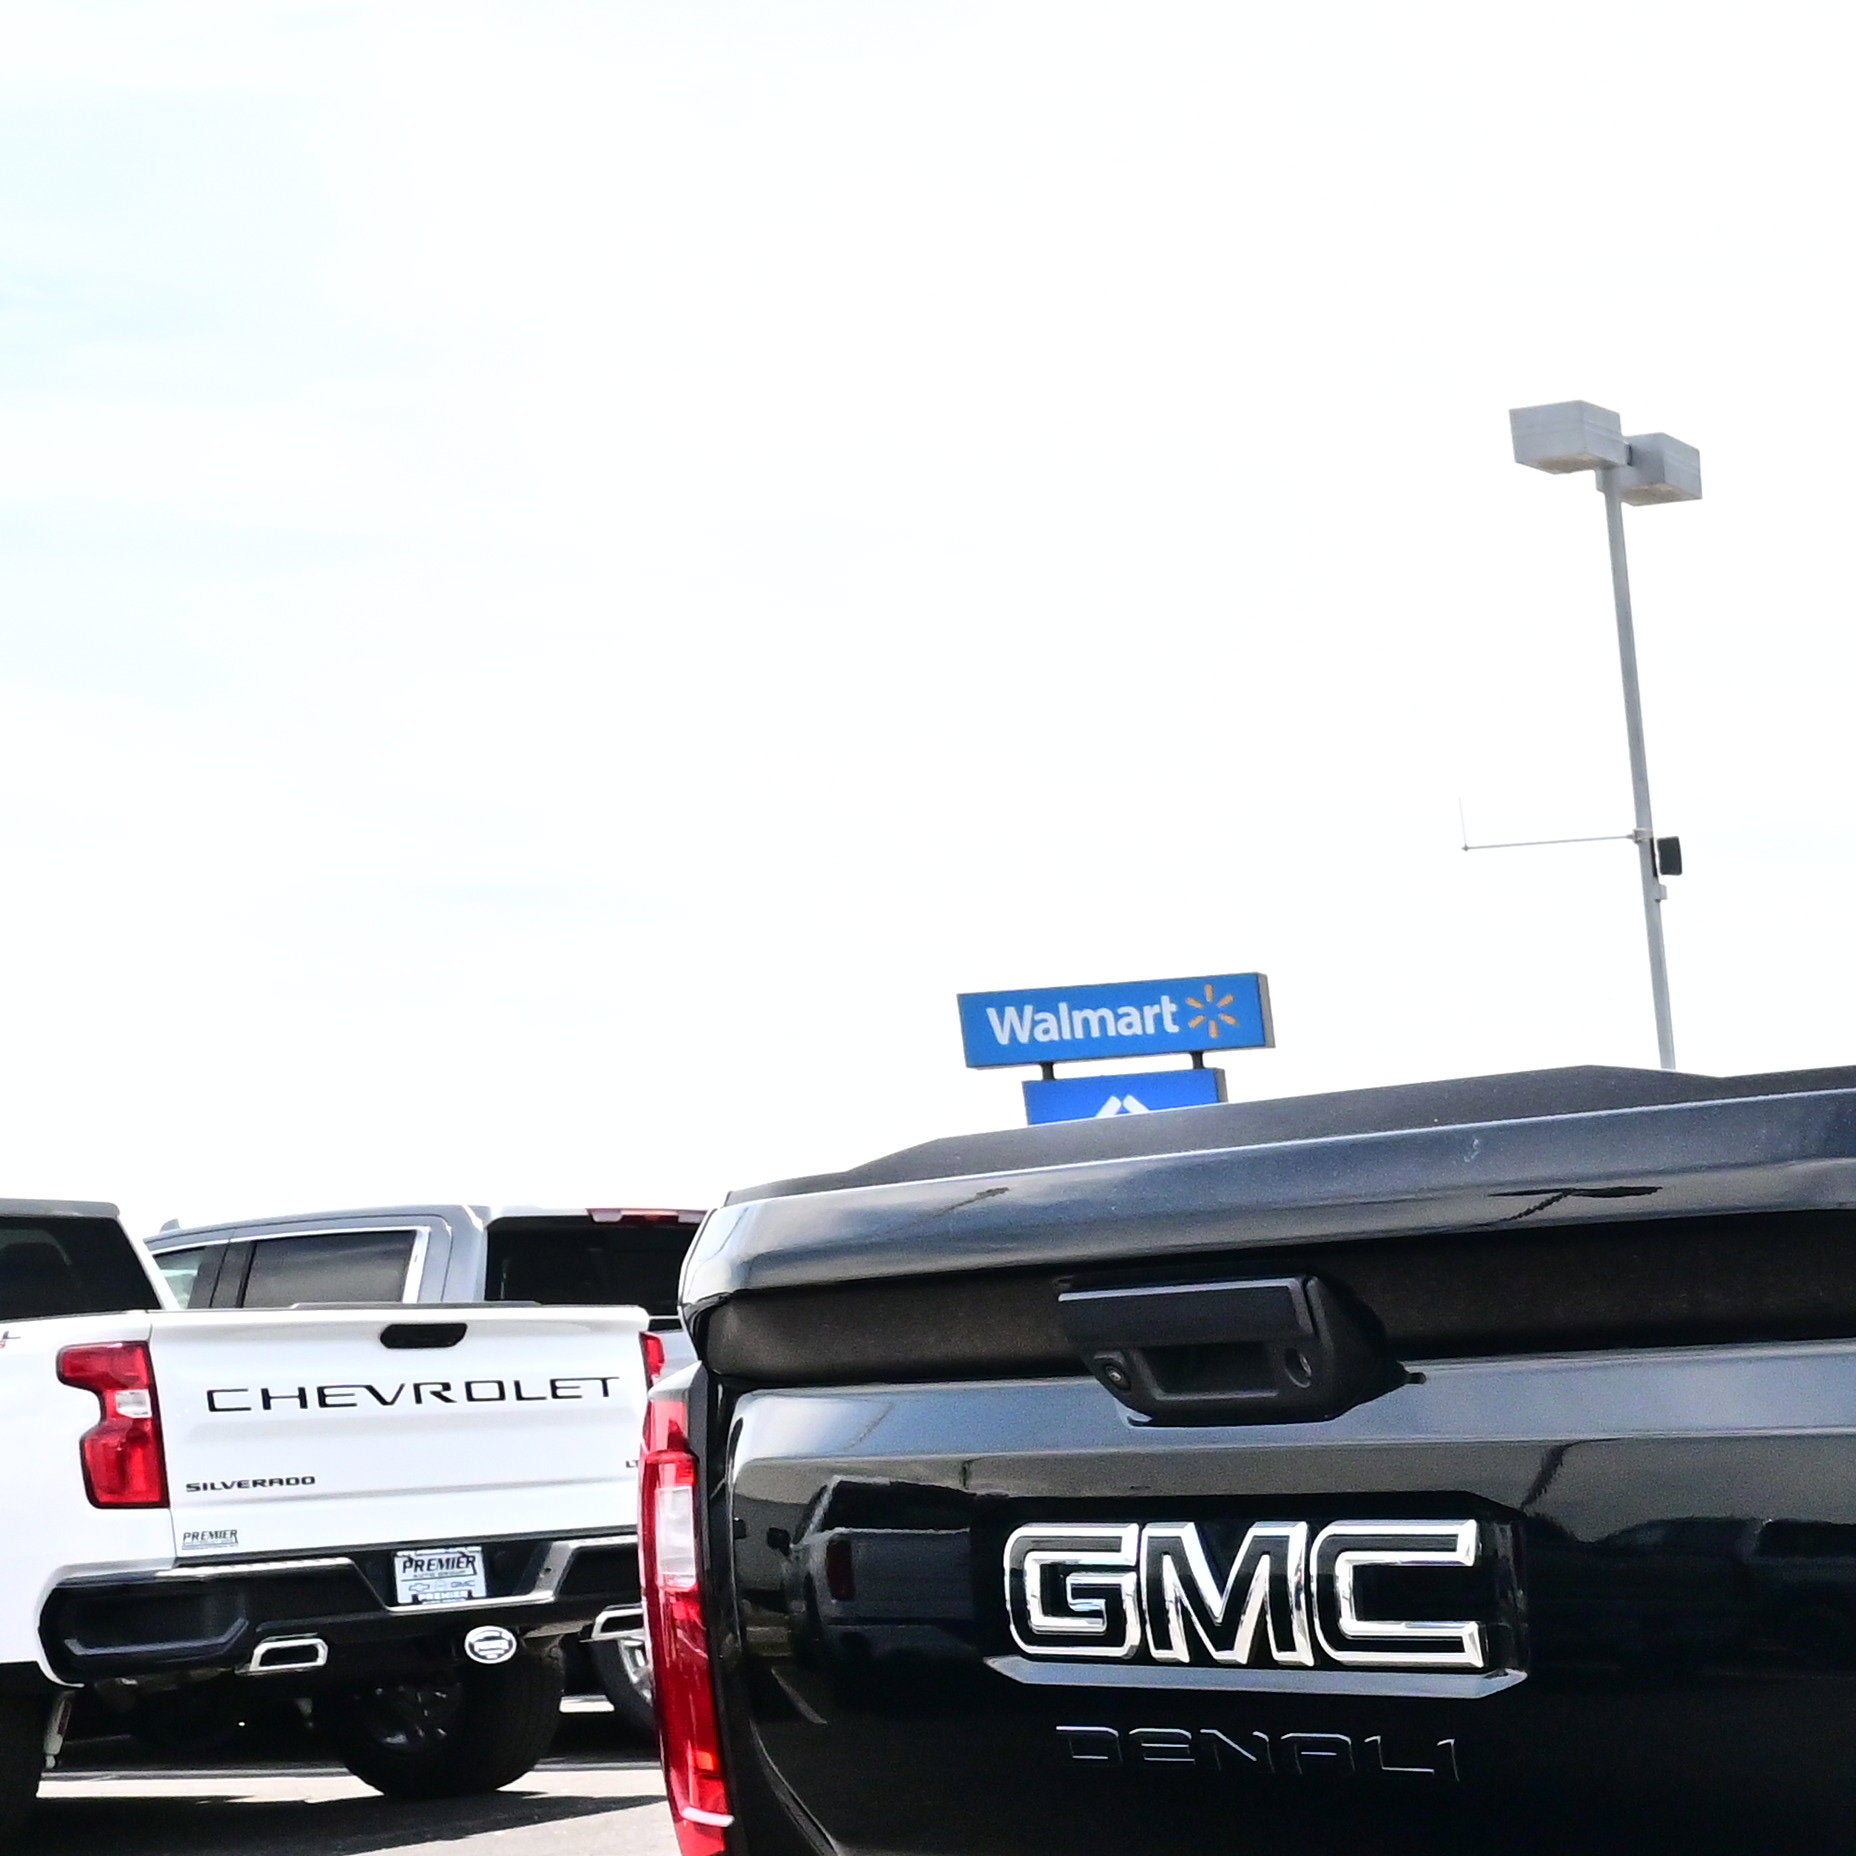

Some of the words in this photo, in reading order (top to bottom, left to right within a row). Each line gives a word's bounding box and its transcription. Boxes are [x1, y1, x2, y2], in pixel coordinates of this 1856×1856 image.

[986, 995, 1180, 1045] Walmart
[207, 1376, 620, 1412] CHEVROLET
[186, 1475, 316, 1492] SILVERADO
[183, 1529, 239, 1543] PREMIER
[402, 1555, 477, 1575] PREMIER
[1003, 1519, 1485, 1668] GMC
[1055, 1726, 1460, 1783] DENALI
